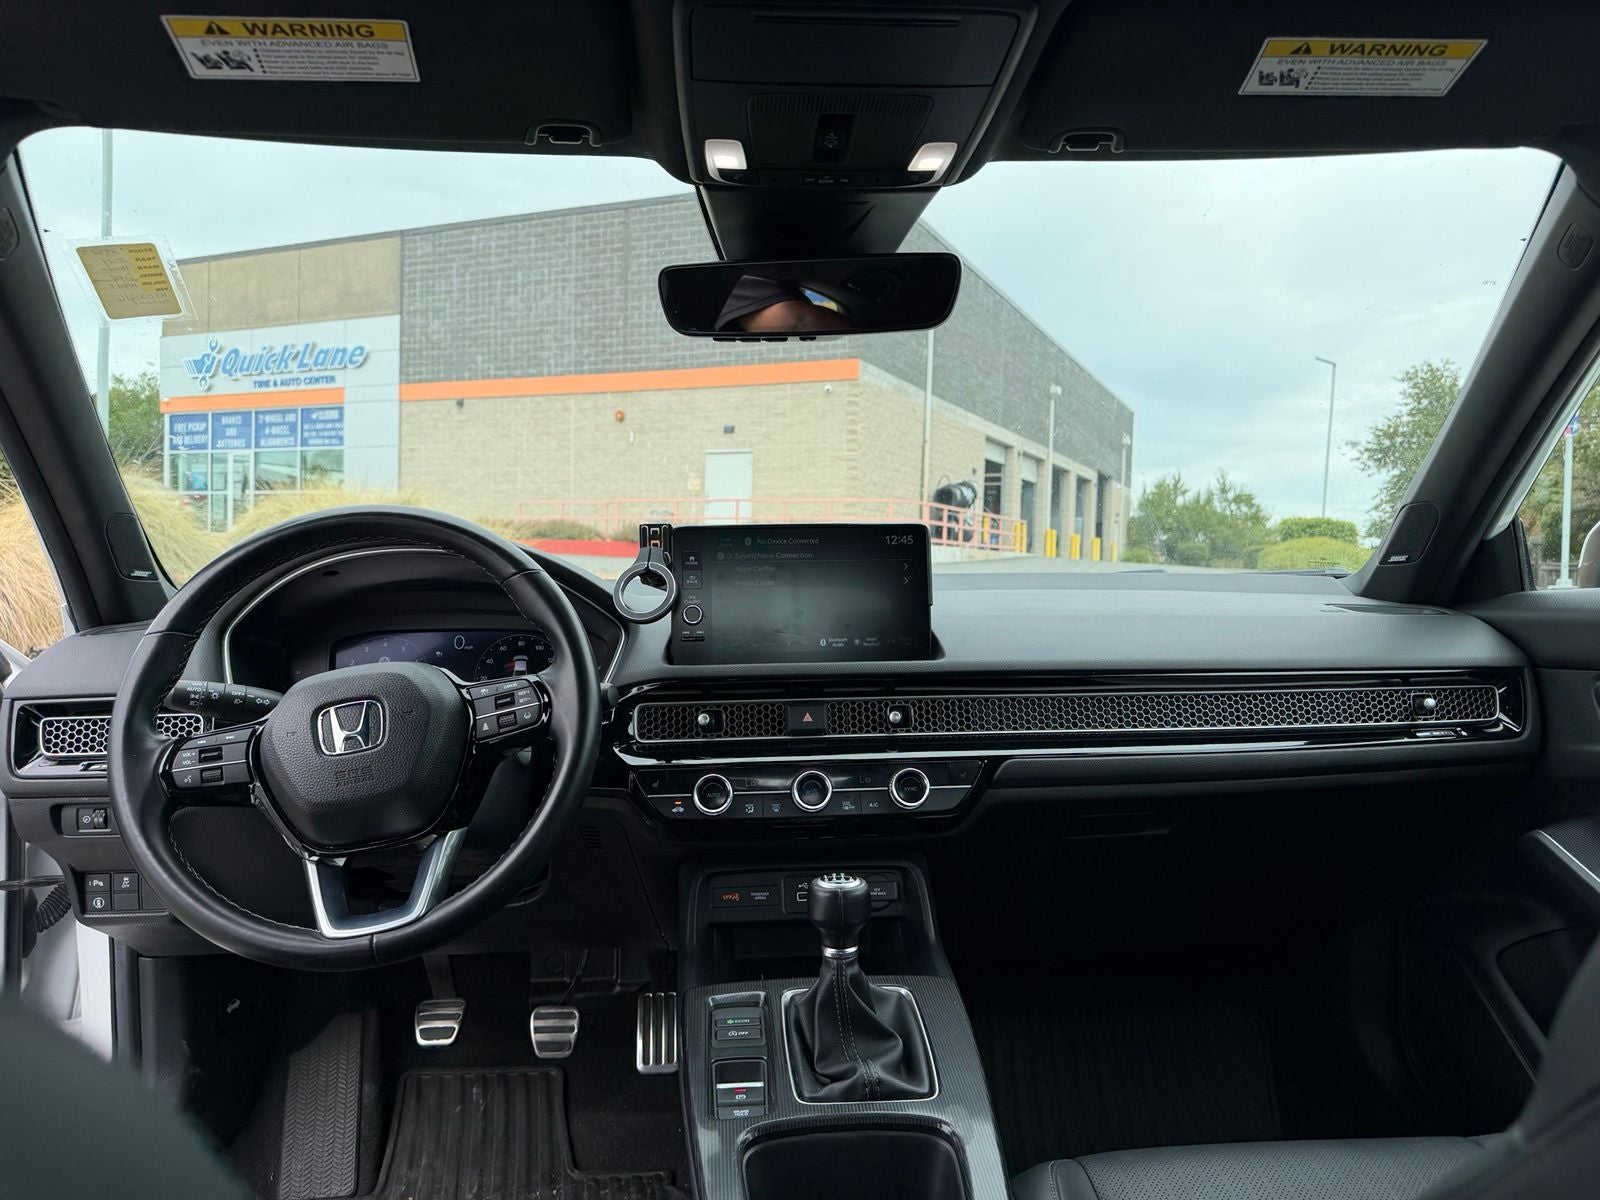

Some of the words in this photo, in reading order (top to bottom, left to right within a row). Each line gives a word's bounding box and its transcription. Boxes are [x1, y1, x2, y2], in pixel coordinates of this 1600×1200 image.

[242, 22, 375, 37] WARNING
[201, 39, 233, 47] EVEN
[270, 40, 333, 48] ADVANCED
[1329, 43, 1448, 56] WARNING
[221, 344, 292, 377] Quick
[297, 342, 366, 369] Lane
[253, 380, 271, 388] TIRE
[280, 378, 302, 387] AUTO
[303, 375, 336, 384] CENTER
[885, 535, 914, 544] 12:45
[454, 635, 465, 650] 0
